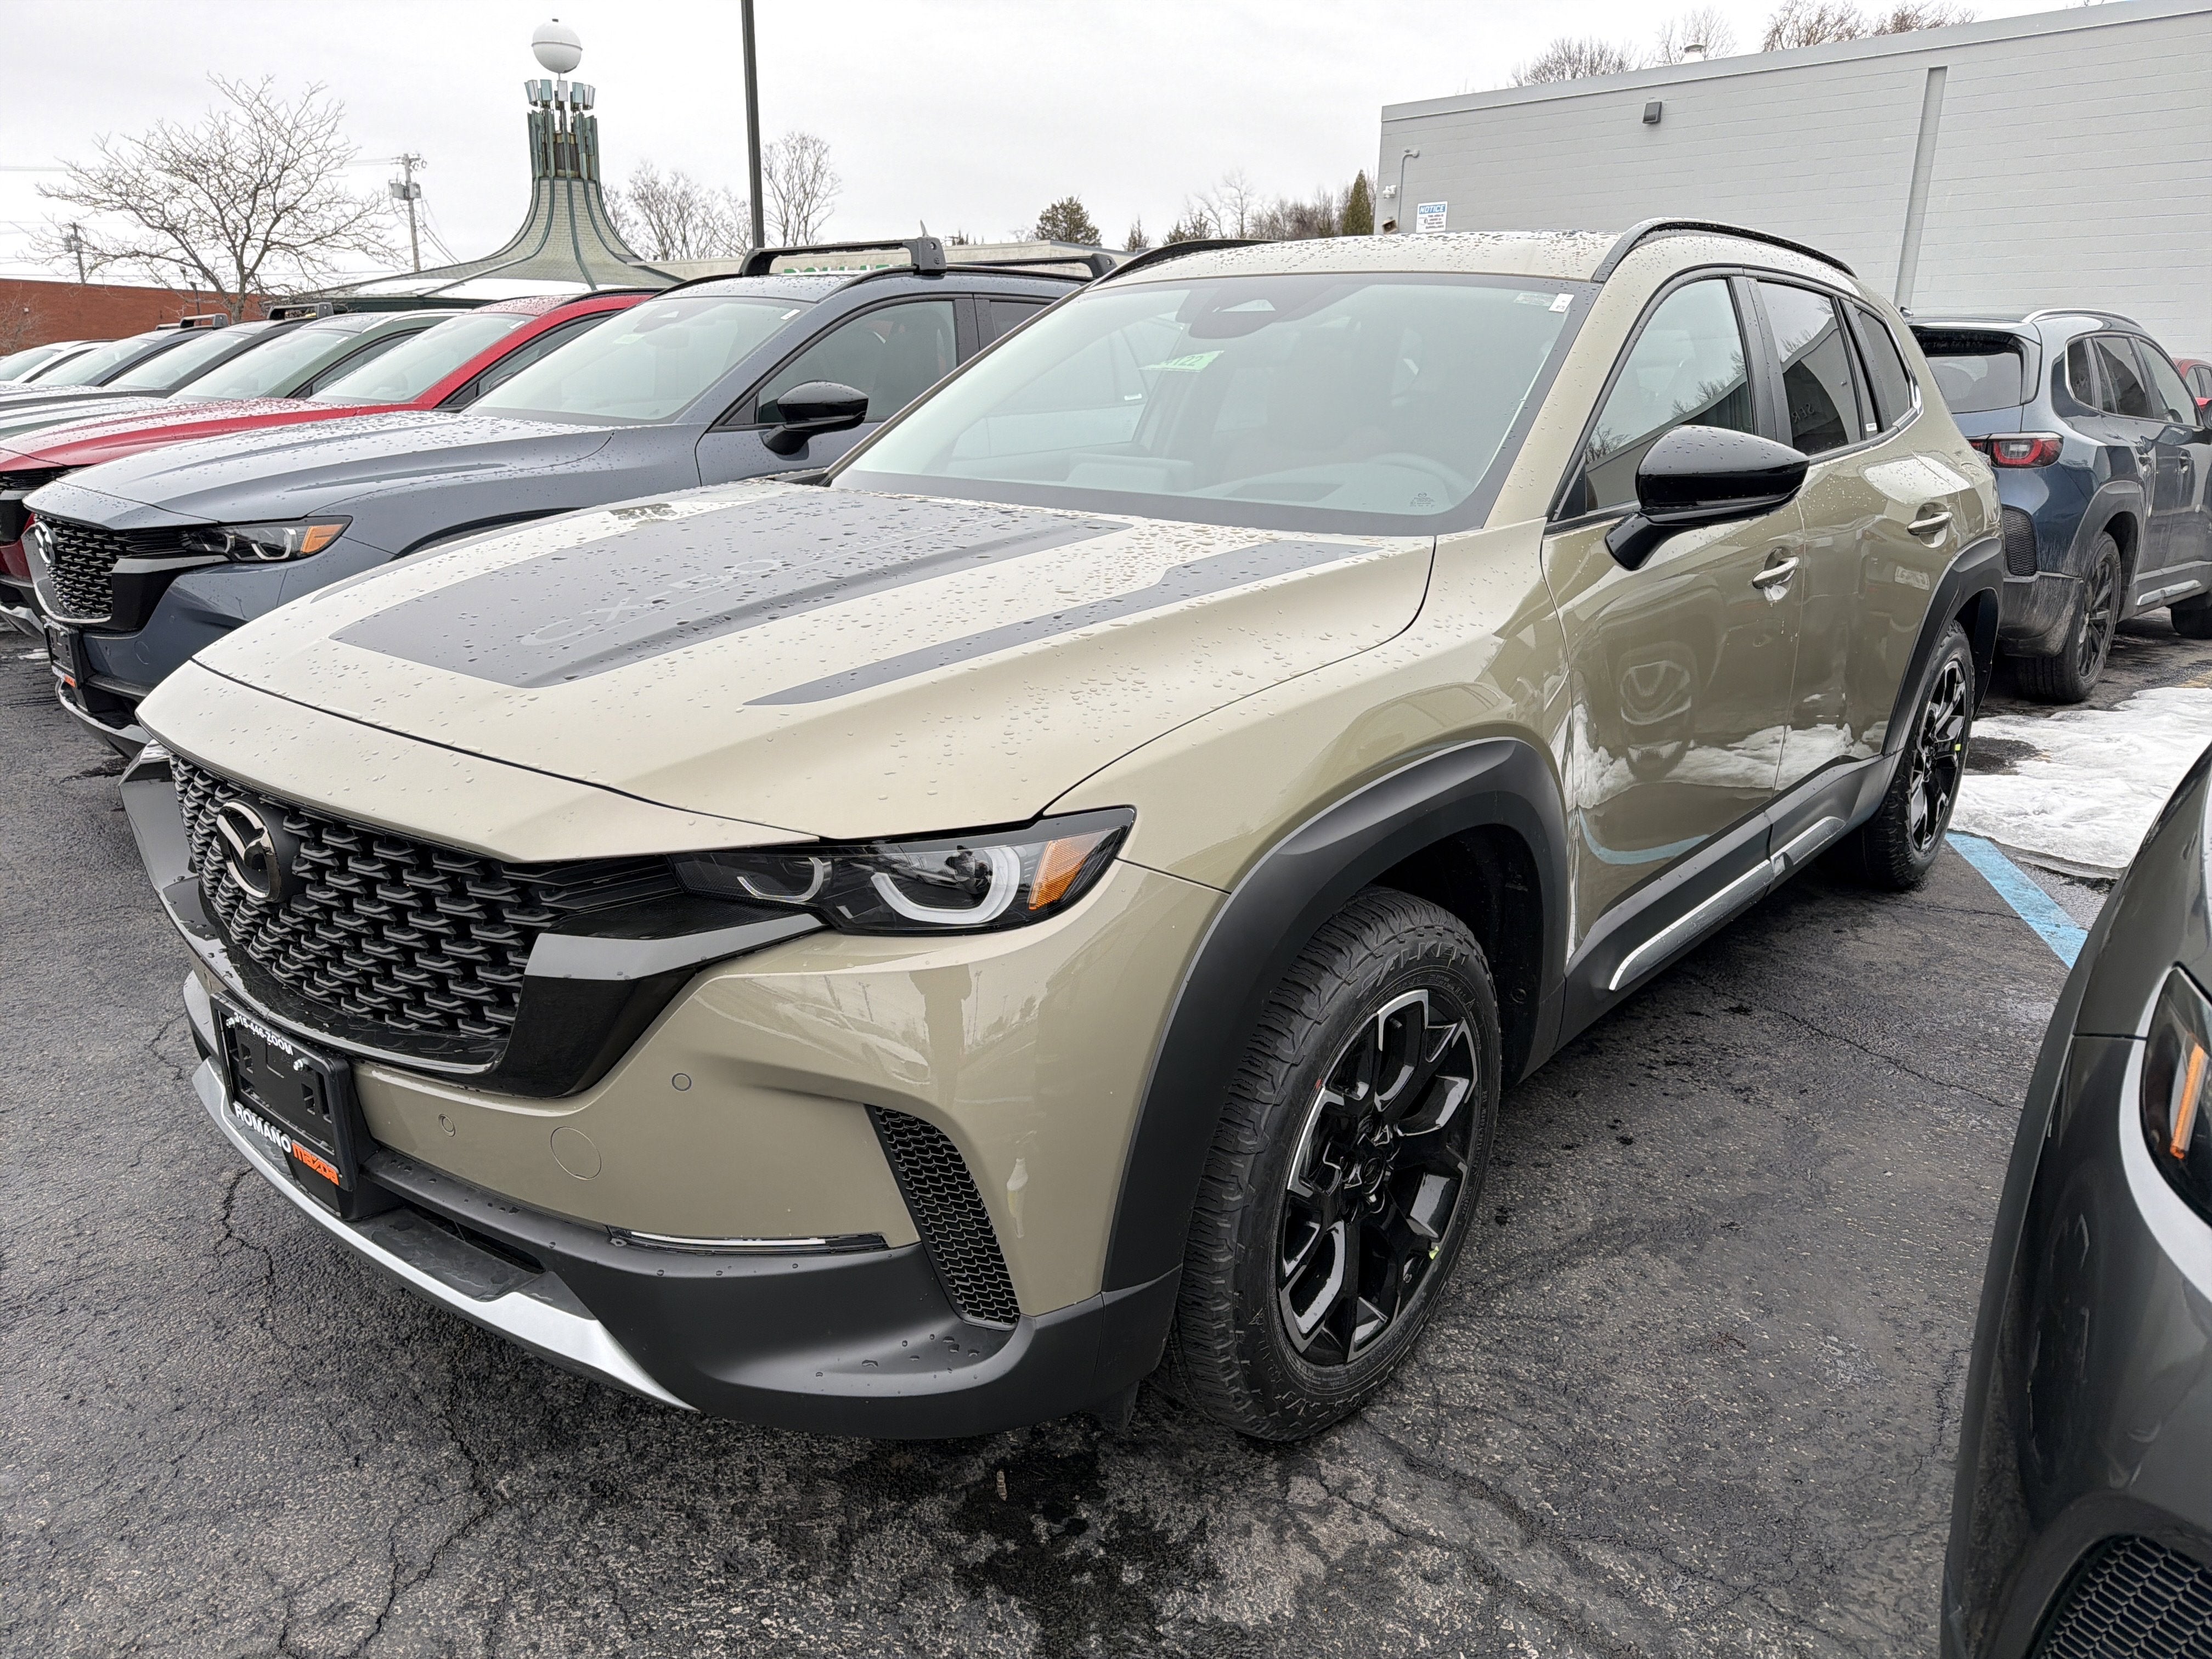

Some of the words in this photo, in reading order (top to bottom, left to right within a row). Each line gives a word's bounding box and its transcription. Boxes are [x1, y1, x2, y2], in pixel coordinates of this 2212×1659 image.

[1419, 205, 1445, 213] NOTICE
[520, 558, 789, 646] CX-50
[234, 1012, 294, 1056] 315-446-ZOOM
[233, 1101, 291, 1153] ROMANO
[292, 1140, 340, 1186] mazda
